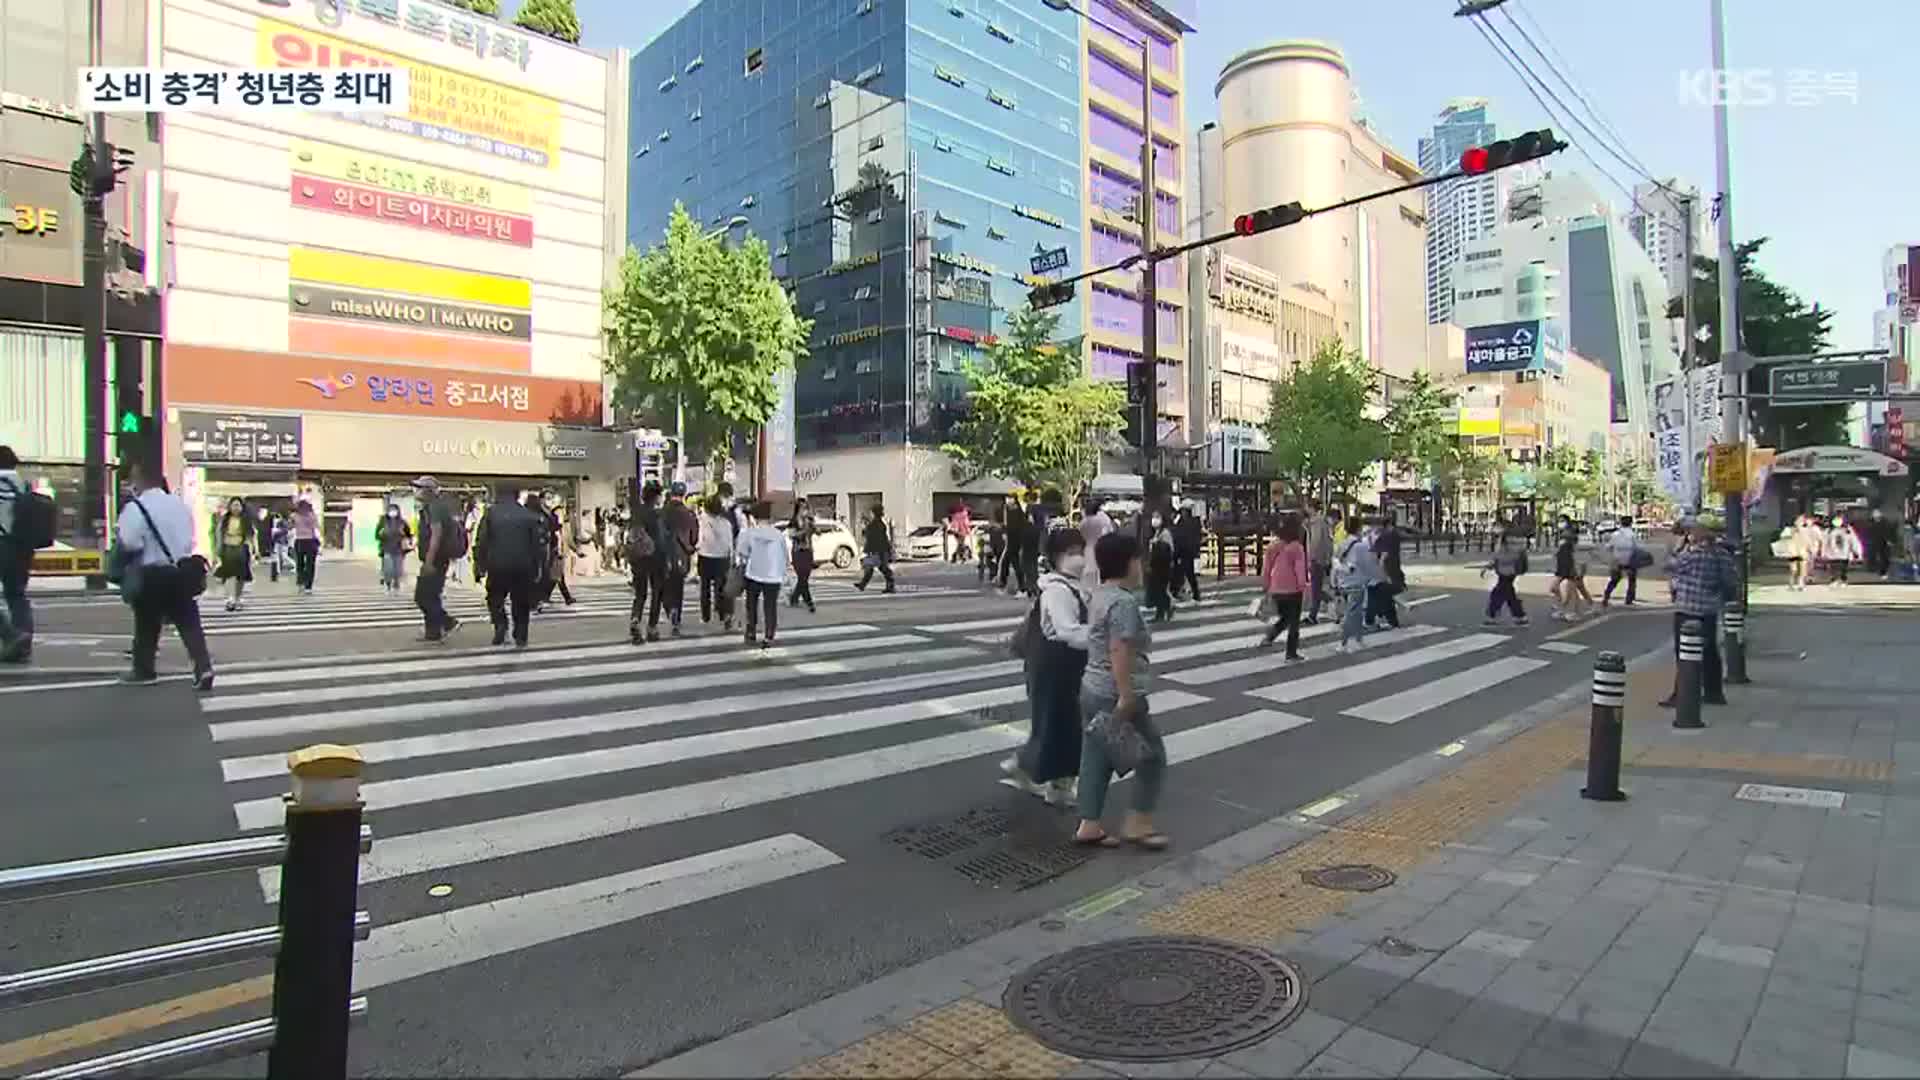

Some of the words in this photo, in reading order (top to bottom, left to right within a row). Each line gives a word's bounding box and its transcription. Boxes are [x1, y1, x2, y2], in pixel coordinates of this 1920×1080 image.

[15, 204, 58, 236] 3F
[331, 298, 426, 322] missWHO
[441, 311, 514, 333] Mr.WHO
[1468, 346, 1533, 364] 새마을금고
[367, 375, 436, 406] 알라딘
[444, 380, 529, 410] 중고서점
